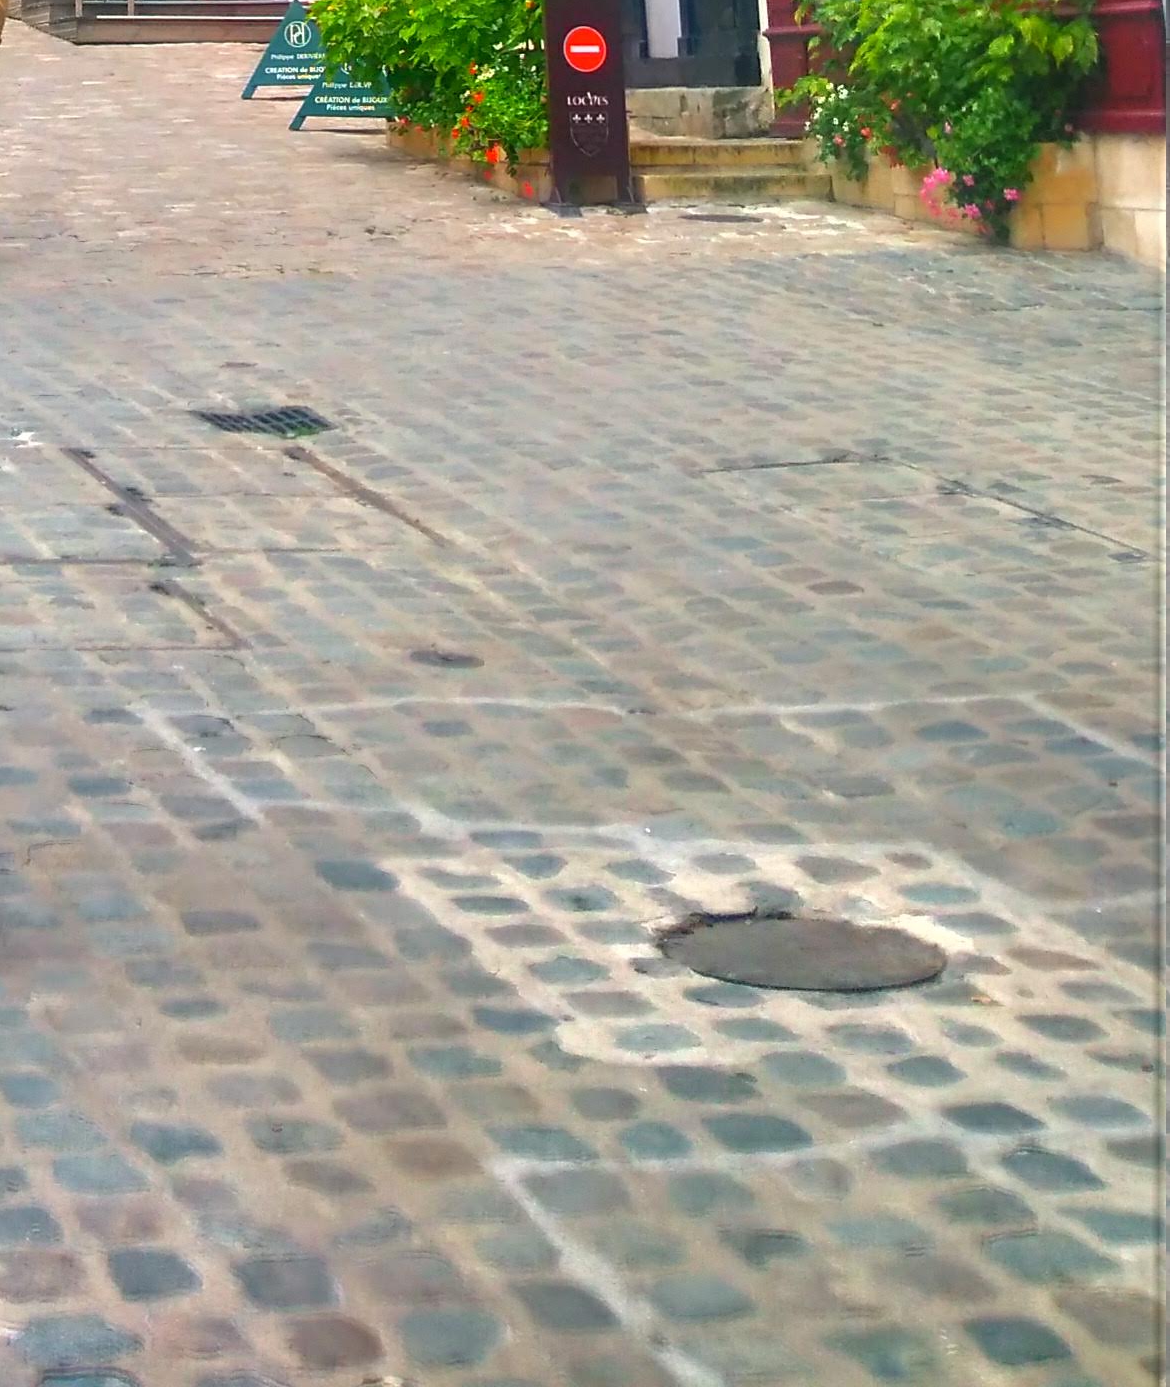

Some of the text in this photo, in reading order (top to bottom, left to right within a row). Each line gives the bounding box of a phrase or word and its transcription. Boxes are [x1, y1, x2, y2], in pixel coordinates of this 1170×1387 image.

[299, 66, 309, 74] de
[309, 65, 326, 74] BIJO
[314, 94, 351, 104] CRÉATION
[351, 95, 361, 104] de
[348, 103, 376, 112] uniques
